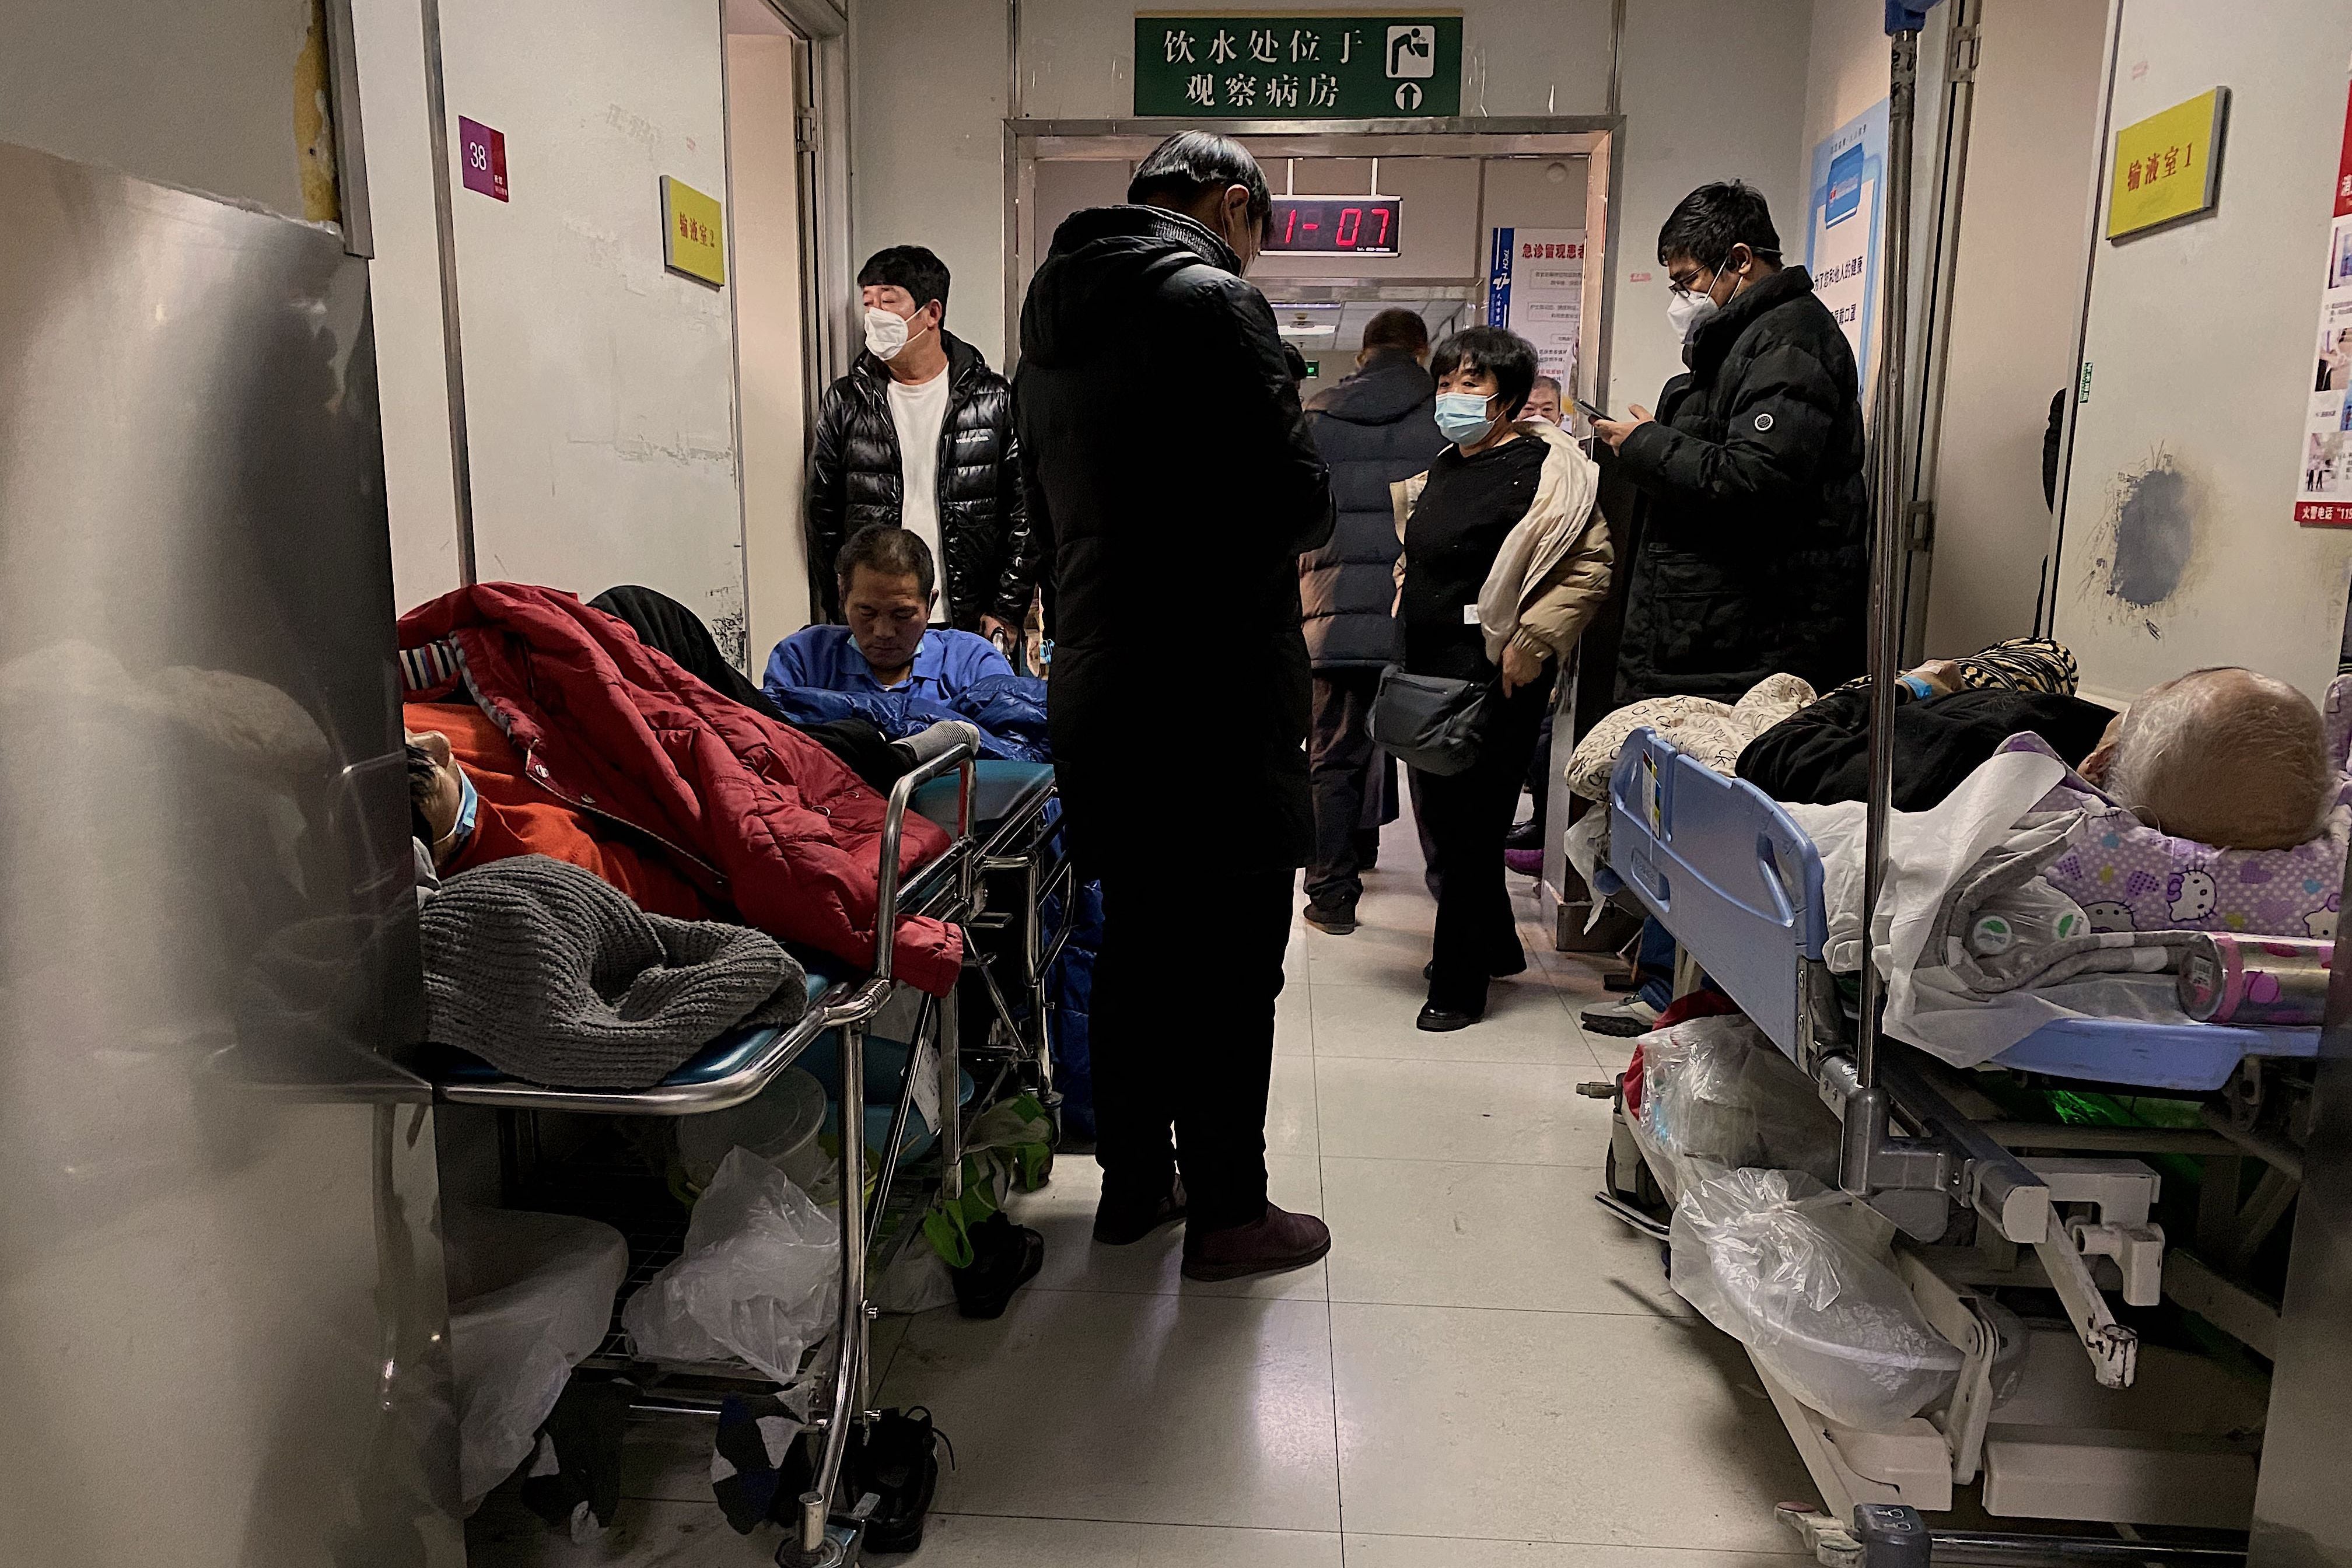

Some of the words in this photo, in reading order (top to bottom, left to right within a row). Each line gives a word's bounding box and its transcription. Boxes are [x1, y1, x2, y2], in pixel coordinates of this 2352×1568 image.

[1163, 29, 1364, 64] 饮水处位于
[1184, 74, 1339, 107] 观察病房
[470, 141, 487, 171] 38
